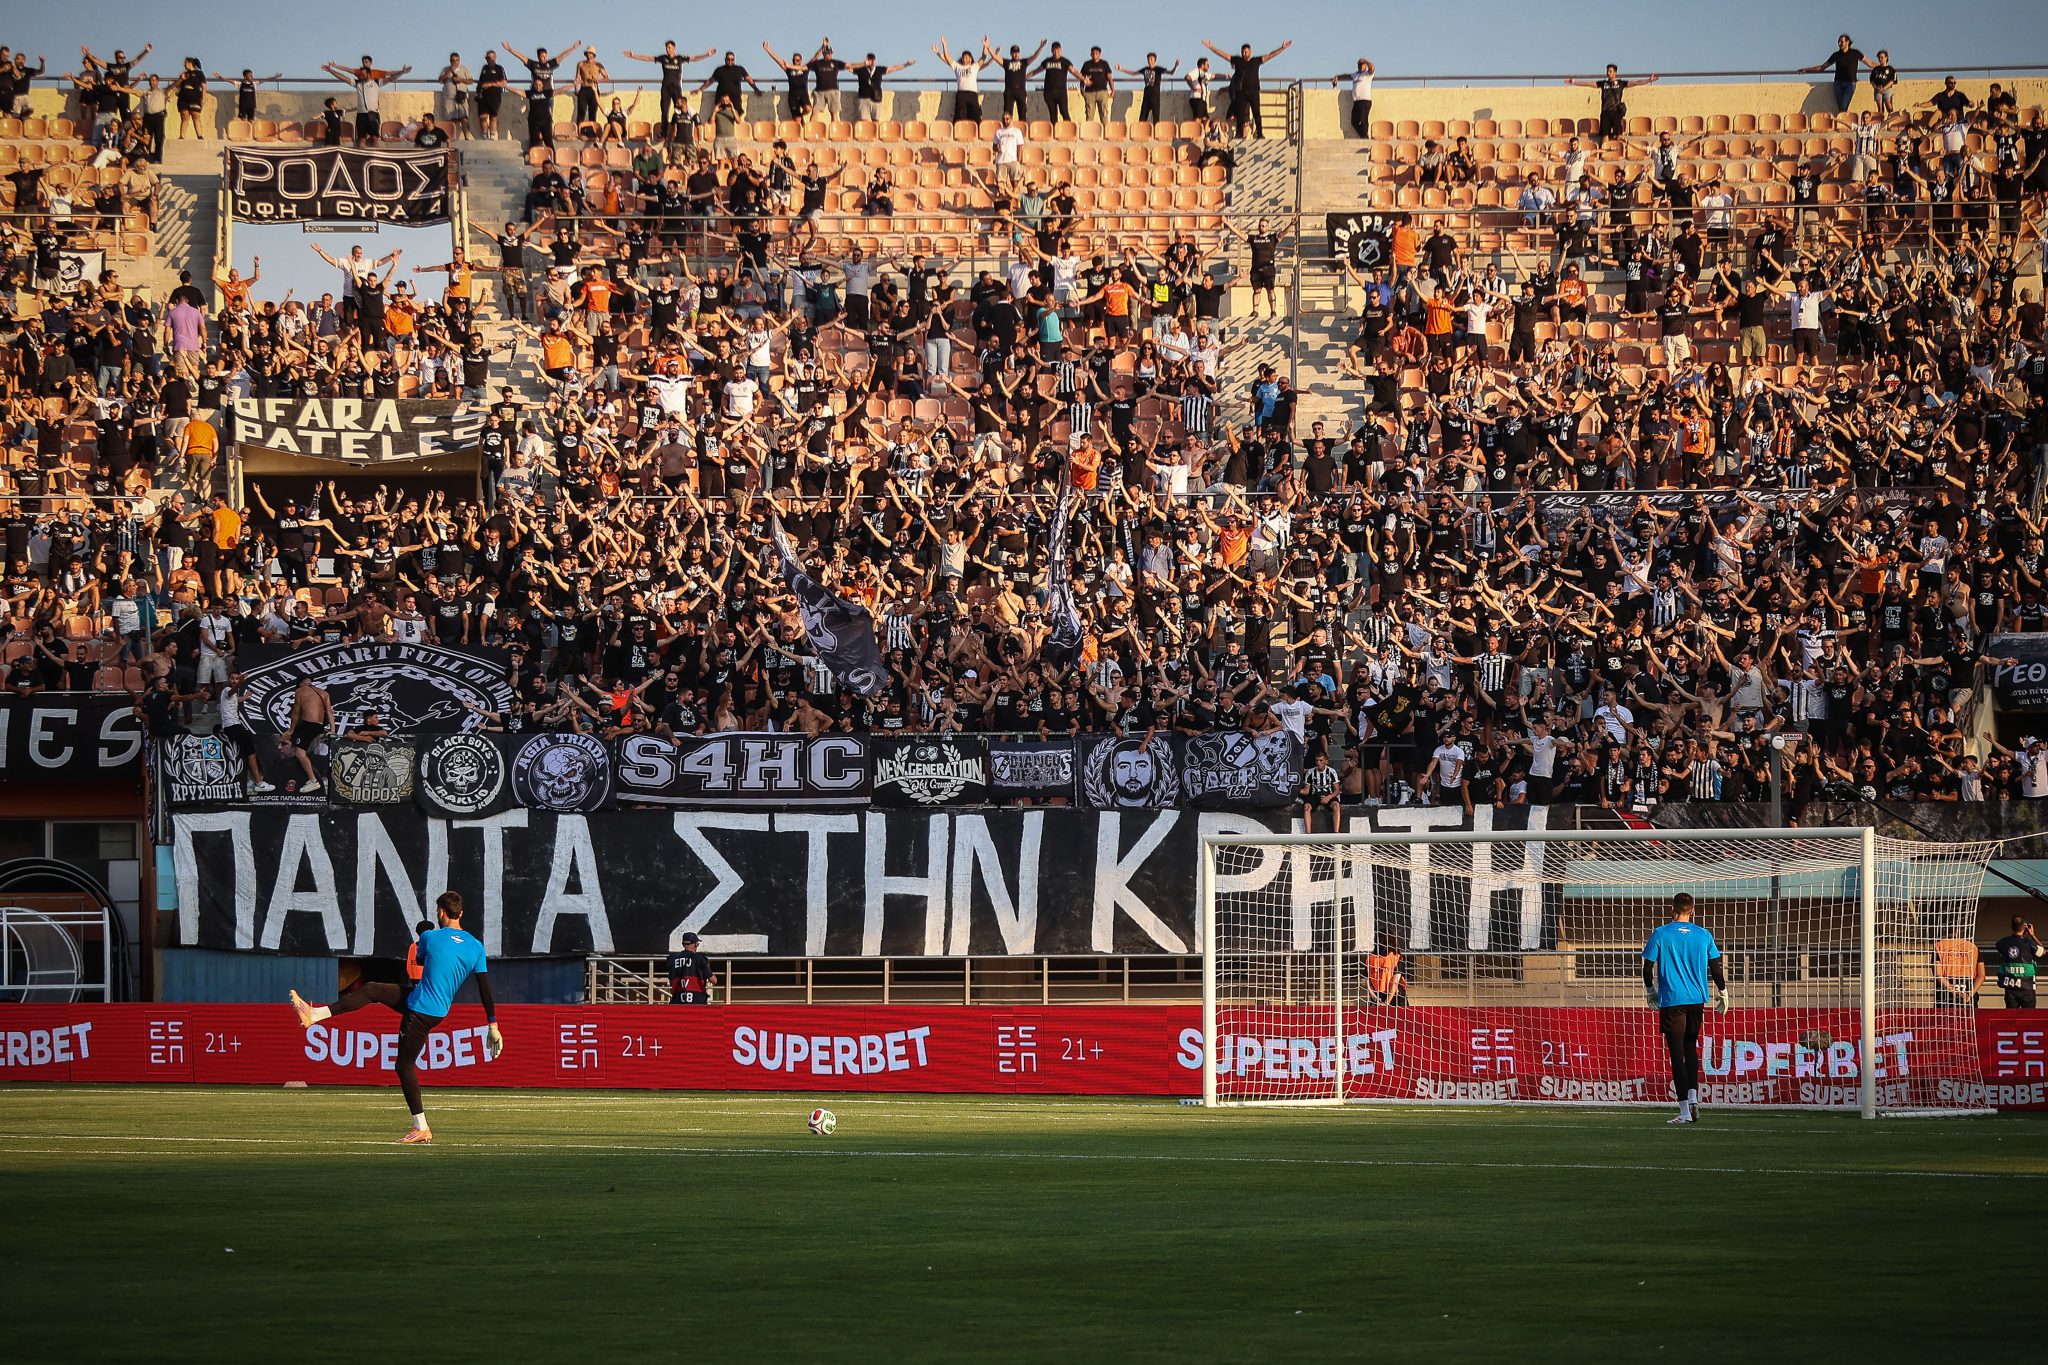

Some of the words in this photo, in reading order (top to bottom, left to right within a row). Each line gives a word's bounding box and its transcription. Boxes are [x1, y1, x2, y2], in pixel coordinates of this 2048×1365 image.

[231, 153, 445, 200] ΡΟΔΟΣ
[336, 200, 411, 219] ΘΥΡΑ
[235, 416, 486, 460] PATELES
[277, 670, 297, 682] A
[295, 645, 392, 679] HEART
[400, 645, 462, 674] FULL
[465, 668, 497, 685] OF
[431, 735, 466, 758] BLACK
[468, 736, 494, 760] BOYS
[518, 738, 551, 769] AGIA
[555, 733, 607, 769] TRIADA
[619, 734, 864, 791] S4HC
[172, 781, 244, 802] ΧΡΥΣΟΠΗΓΗ
[351, 786, 400, 804] ΠΟΡΟΣ
[434, 785, 489, 805] IRAKLIO
[173, 810, 615, 957] ΠΑΝΤΑ
[669, 810, 1044, 957] ΣΤΗΝ
[1092, 804, 1549, 956] ΚΡΗΤΗ
[205, 1032, 242, 1053] 21+
[621, 1035, 663, 1057] 21+
[732, 1025, 931, 1075] SUPERBET
[1061, 1037, 1104, 1060] 21+
[1541, 1040, 1588, 1065] 21+
[1696, 1031, 1914, 1078] UPERBET
[1416, 1077, 1519, 1100] SUPERBET
[1540, 1075, 1646, 1100] SUPERBET
[1668, 1079, 1777, 1104] SPERBET
[1937, 1079, 2048, 1105] SUPERBE
